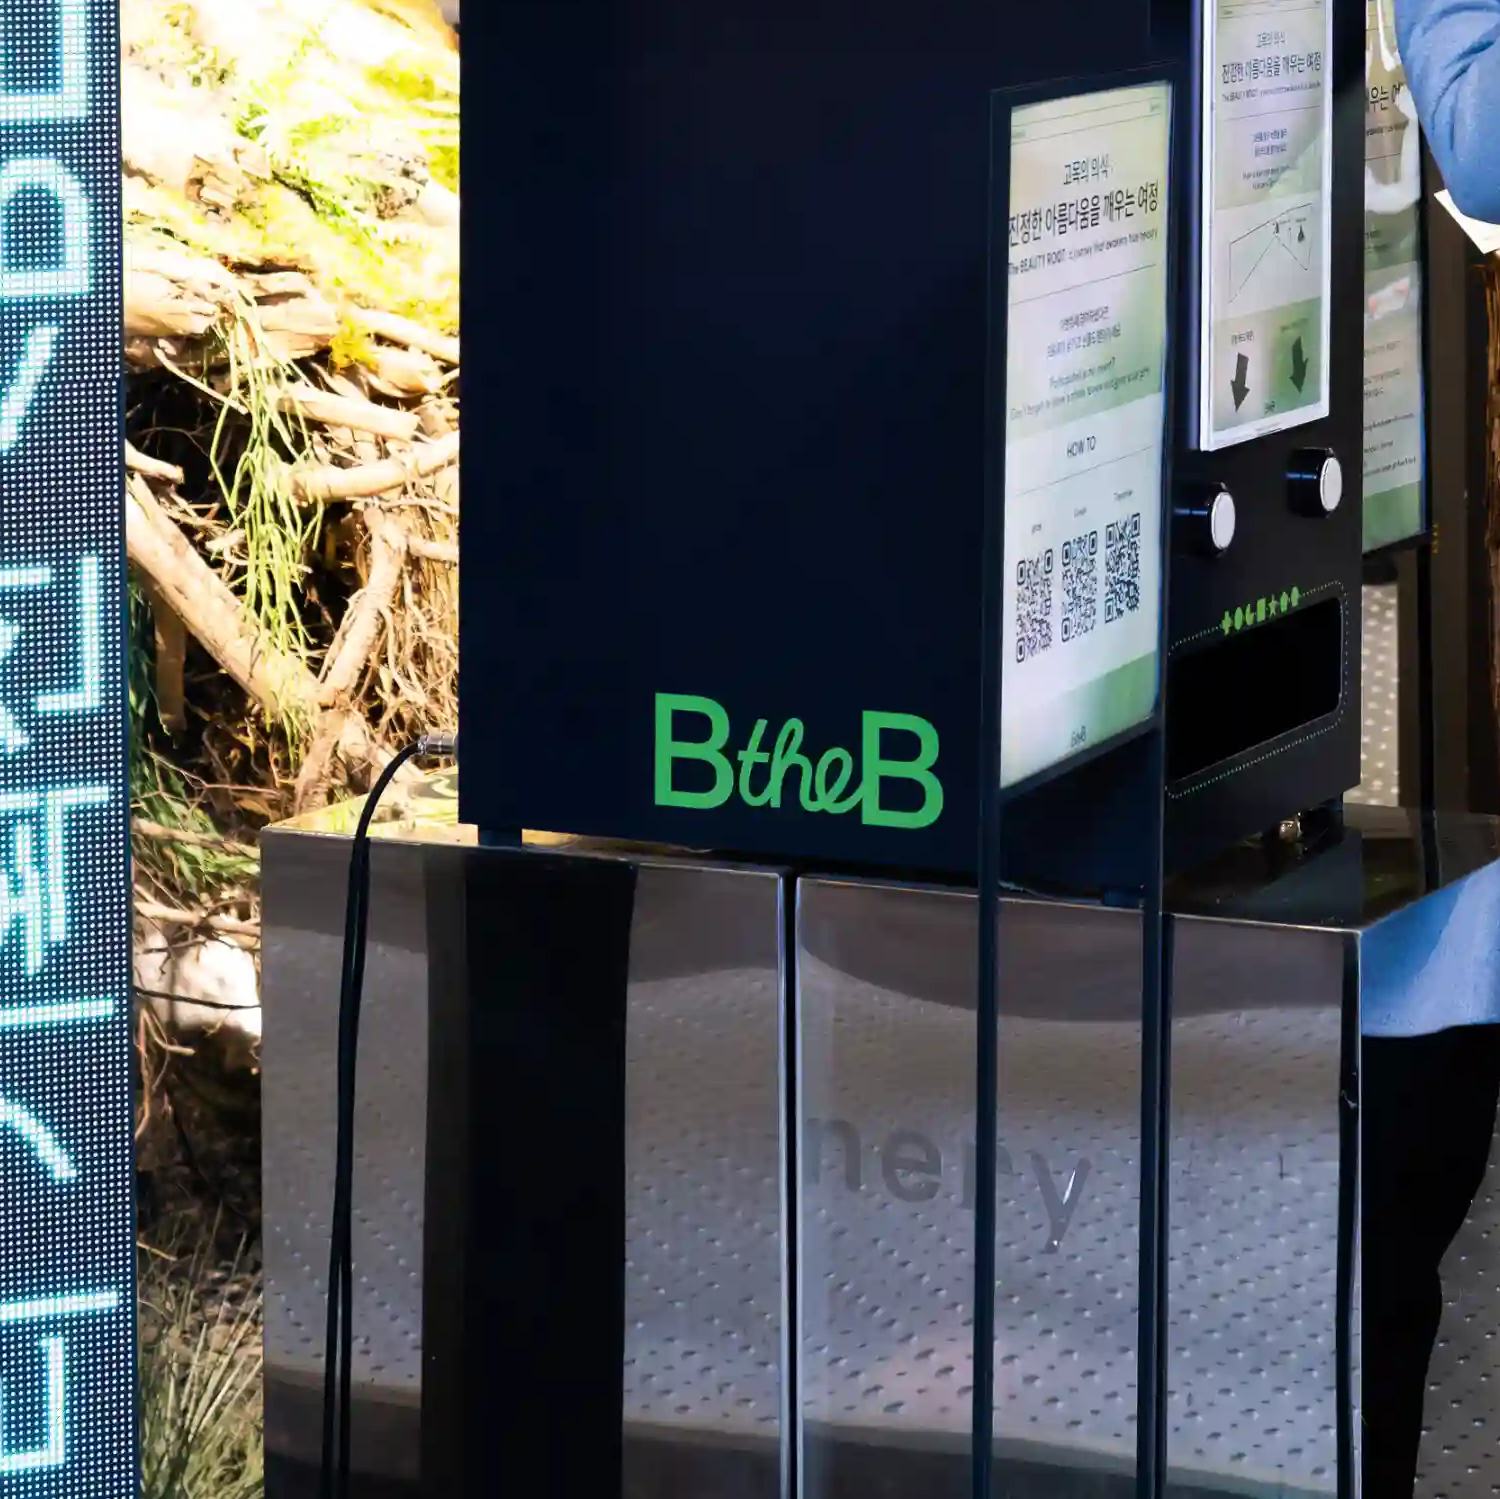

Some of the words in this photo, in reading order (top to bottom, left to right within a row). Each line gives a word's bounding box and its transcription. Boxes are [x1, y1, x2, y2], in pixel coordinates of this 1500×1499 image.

[1009, 207, 1042, 247] 진정한
[1045, 195, 1100, 236] 아름다움을
[1103, 188, 1135, 222] 깨우는
[1138, 178, 1158, 214] 여정
[1066, 440, 1085, 458] HOW
[1086, 435, 1097, 452] TO
[655, 692, 944, 829] BtheB
